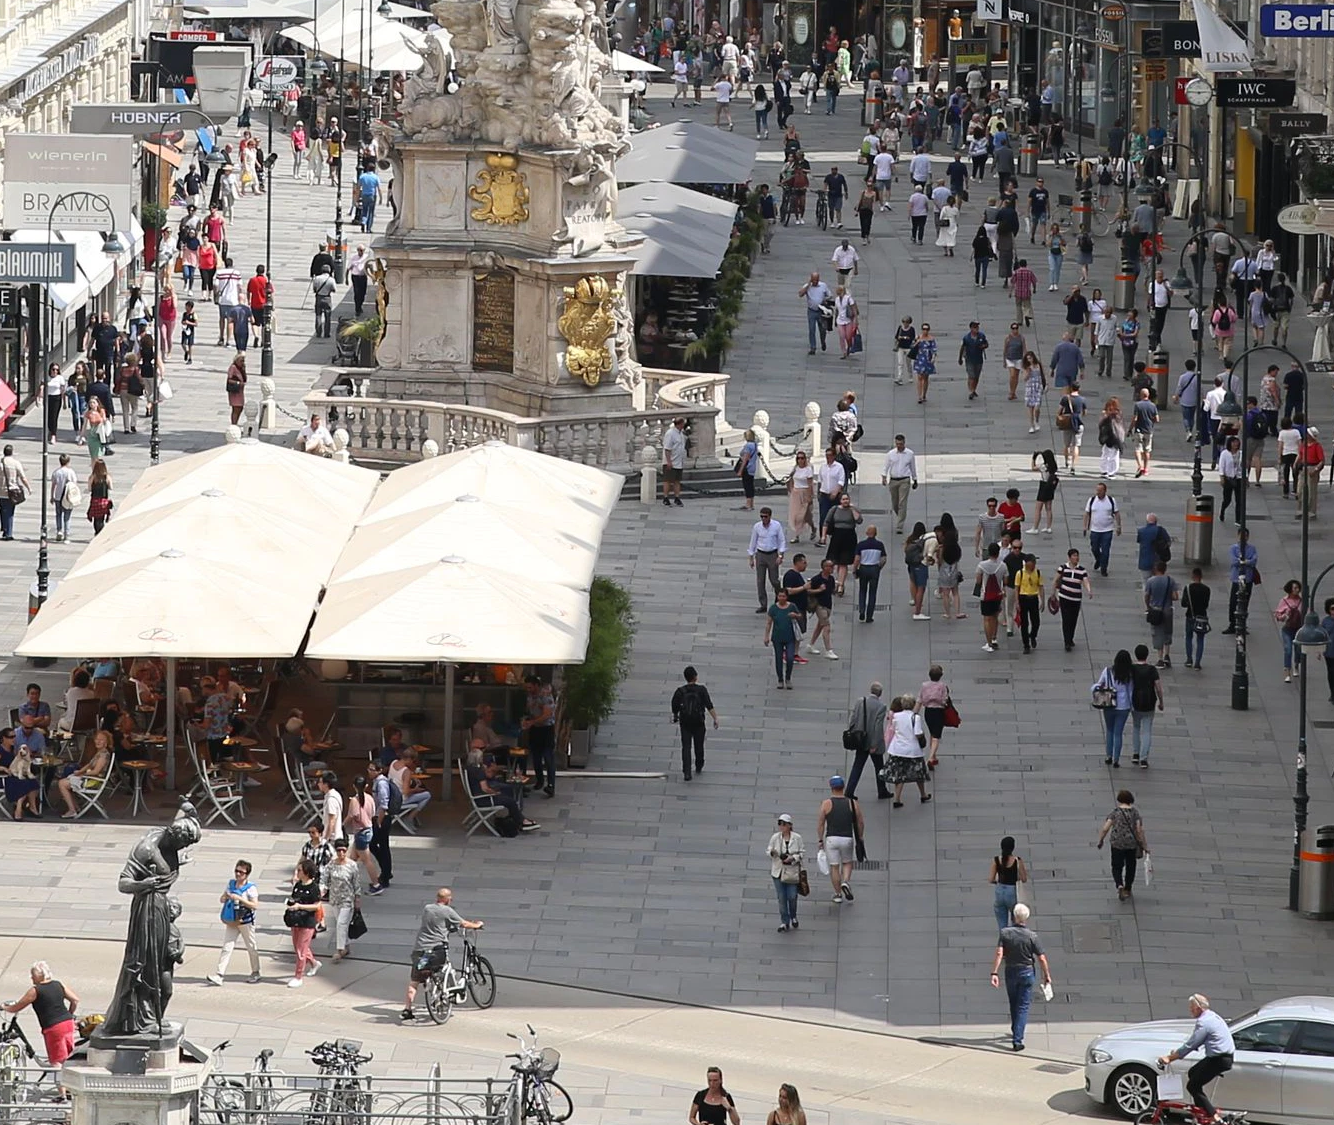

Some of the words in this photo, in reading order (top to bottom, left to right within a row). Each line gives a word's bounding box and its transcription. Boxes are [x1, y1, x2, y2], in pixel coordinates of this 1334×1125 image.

[1095, 27, 1115, 43] FOSSIL
[1206, 52, 1251, 64] LISKA
[1238, 83, 1266, 95] IWC
[111, 112, 181, 124] HÜBNER
[27, 150, 108, 162] wienerin
[23, 193, 110, 212] BRAMO
